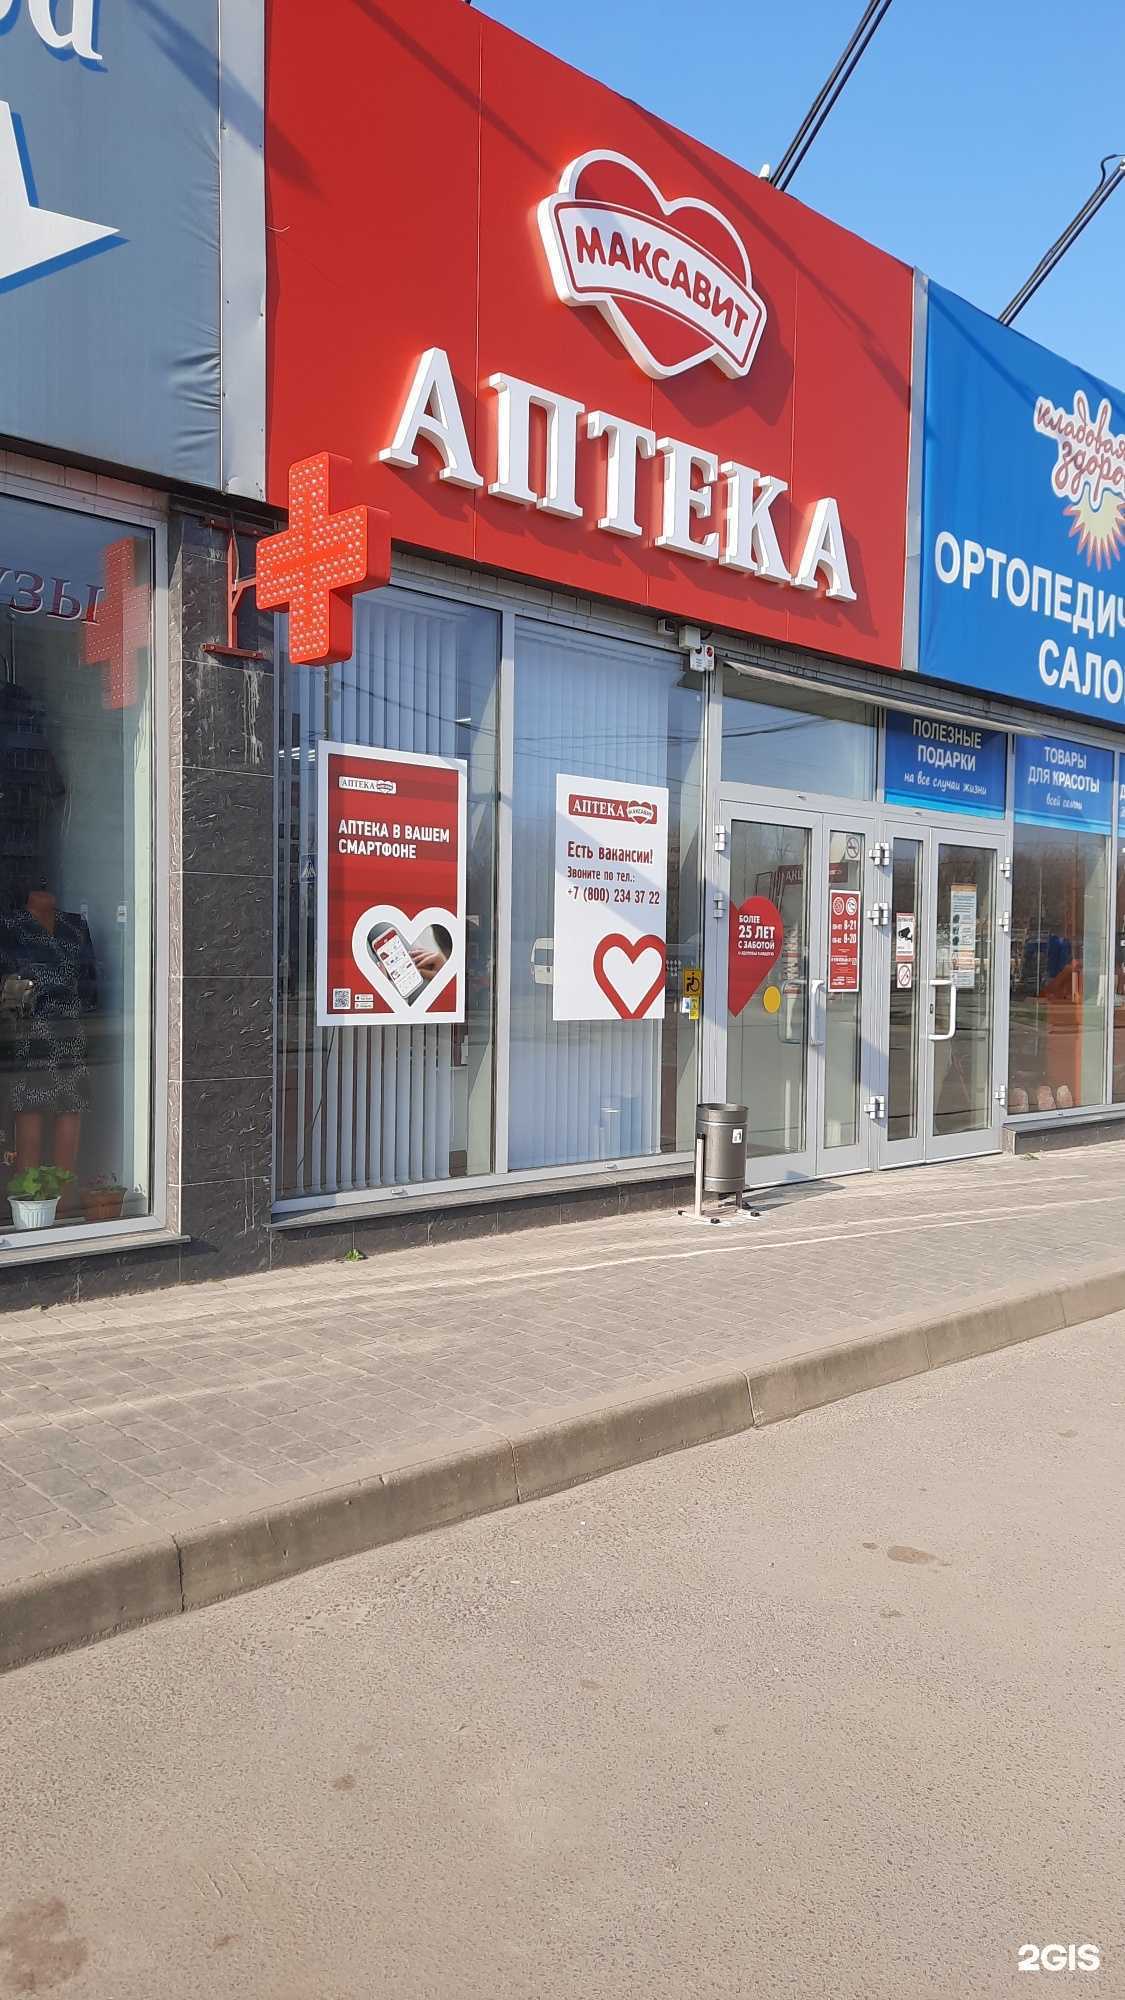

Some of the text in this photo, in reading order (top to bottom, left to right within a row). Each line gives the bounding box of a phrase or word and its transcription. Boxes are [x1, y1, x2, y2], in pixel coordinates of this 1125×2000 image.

[575, 225, 749, 338] МАКСАВИТ
[378, 347, 857, 601] АПТЕКА
[1055, 441, 1125, 502] здоро
[1039, 639, 1125, 704] САЛО
[912, 718, 982, 749] ПОЛЕЗНЫЕ
[917, 744, 976, 772] ПОДАРКИ
[1044, 746, 1087, 769] ТОВАРЫ
[341, 779, 375, 790] АПТЕКА
[904, 772, 914, 784] на
[932, 777, 960, 792] случаи
[962, 783, 987, 795] жизни
[1027, 766, 1050, 785] ДЛЯ
[1052, 772, 1100, 794] КРАСОТЫ
[573, 800, 625, 818] АПТЕКА
[338, 819, 450, 843] АПТЕКА В ВАШЕМ
[338, 838, 417, 859] СМАРТФОНЕ
[567, 840, 654, 865] Есть вакансии!
[567, 866, 601, 880] Звоните
[604, 871, 614, 881] по
[567, 886, 660, 905] +7 (800) 234 37 22
[738, 914, 761, 924] БОЛЕЕ
[738, 924, 776, 939] 25 ЛЕТ
